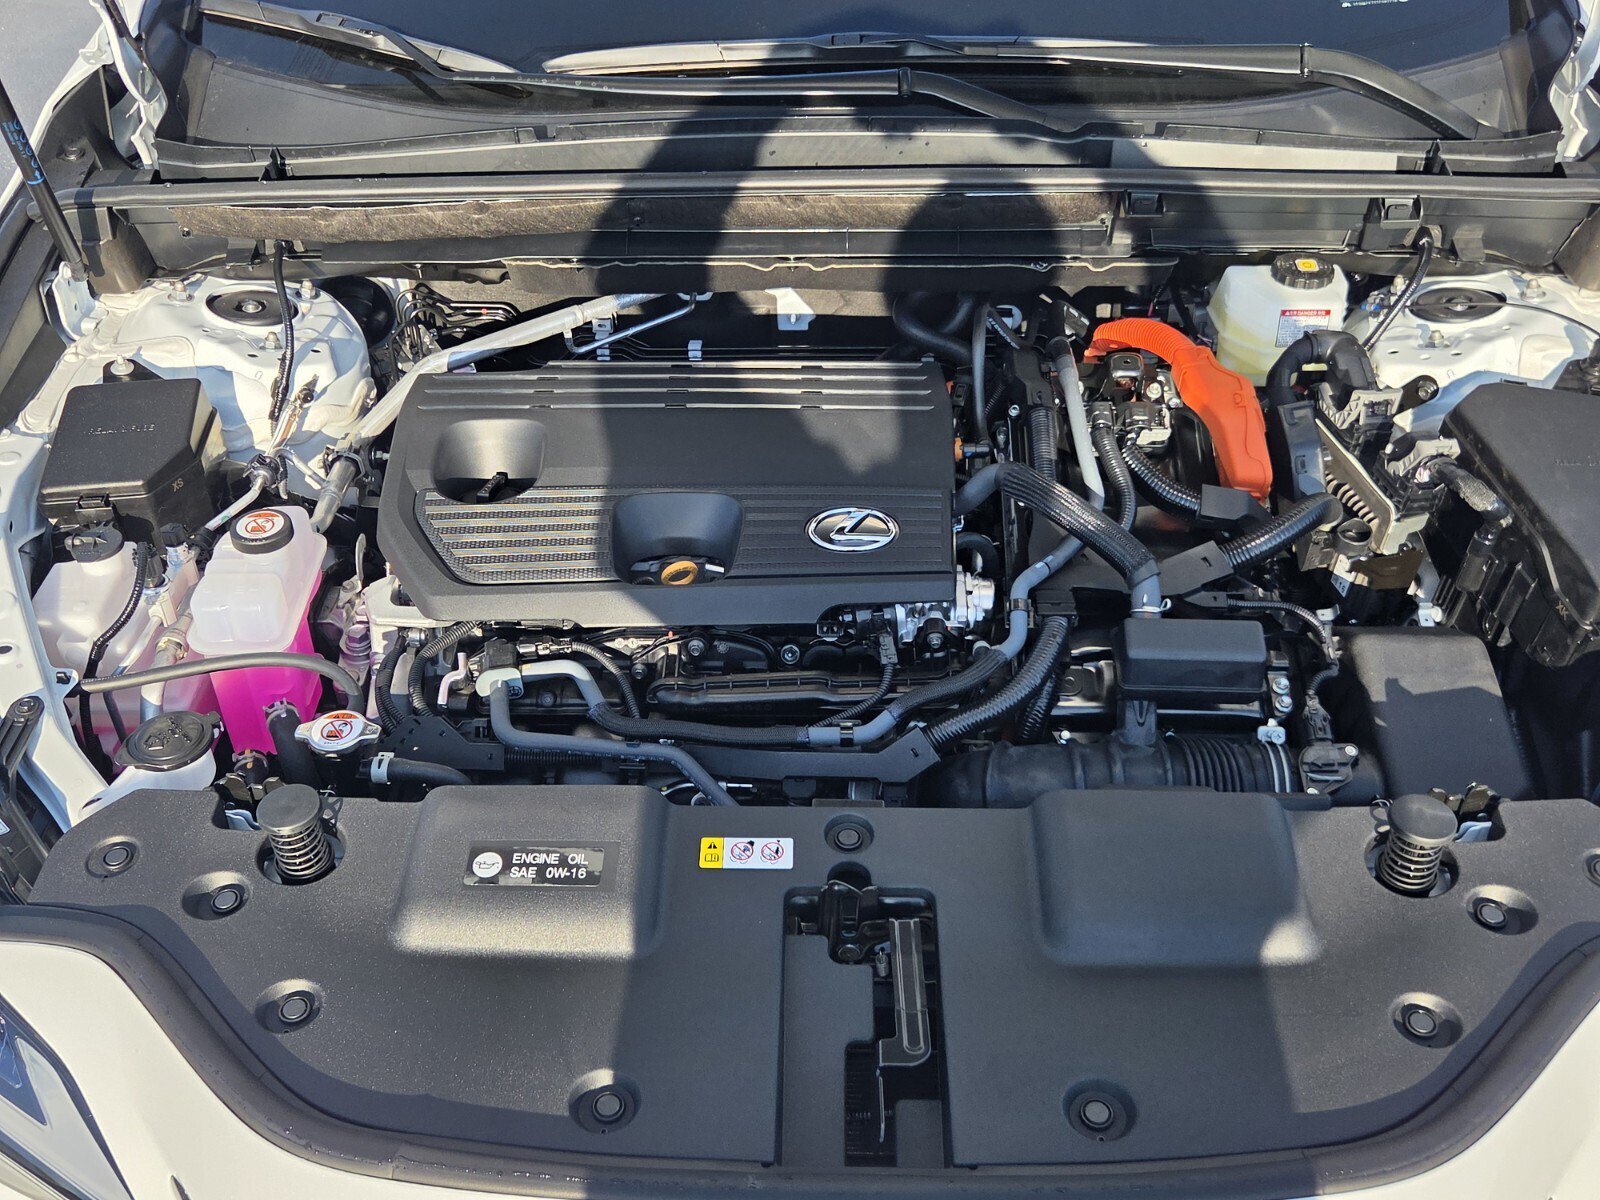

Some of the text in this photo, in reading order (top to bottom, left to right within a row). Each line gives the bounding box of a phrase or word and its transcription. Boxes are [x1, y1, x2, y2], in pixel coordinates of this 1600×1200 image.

[512, 852, 589, 865] ENGINE OIL
[509, 866, 587, 879] SAE 0W-16
